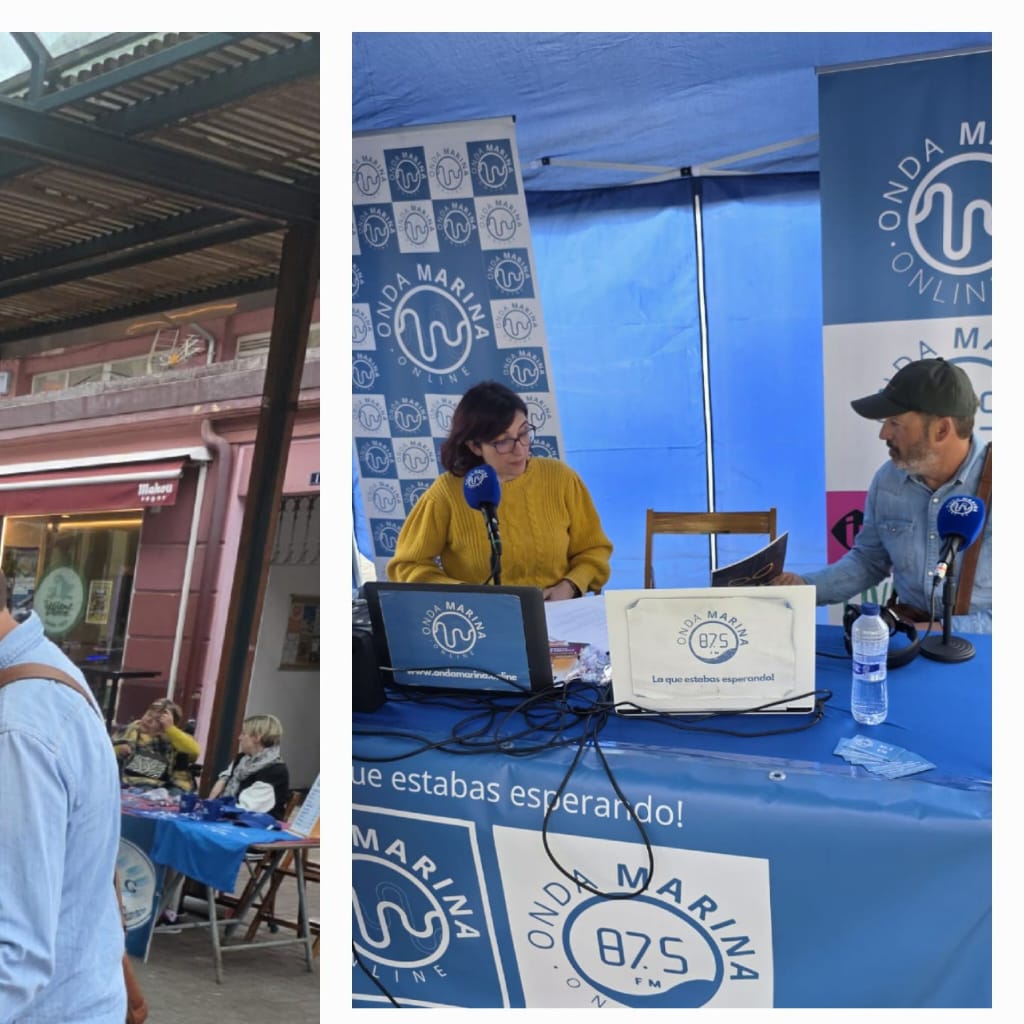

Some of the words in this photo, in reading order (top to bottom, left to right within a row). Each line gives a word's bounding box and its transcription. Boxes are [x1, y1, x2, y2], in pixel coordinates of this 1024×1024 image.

[959, 120, 992, 146] M
[891, 252, 992, 304] ONLIN
[377, 273, 411, 337] ONDA
[417, 263, 490, 339] MARINA
[398, 356, 470, 384] ONLINE
[138, 482, 174, 497] Mahou
[423, 604, 441, 635] ONDA
[446, 601, 487, 640] MARINA
[677, 614, 702, 646] ONDA
[707, 610, 749, 646] MARINA
[665, 677, 683, 686] que
[684, 675, 720, 684] estabas
[722, 673, 775, 685] esperando!
[352, 765, 383, 786] ue
[391, 770, 501, 803] estabas
[510, 785, 684, 828] esperando!
[352, 824, 480, 939] MARINA
[527, 869, 599, 949] ONDA
[617, 863, 760, 981] MARINA
[596, 927, 689, 976] 87.5
